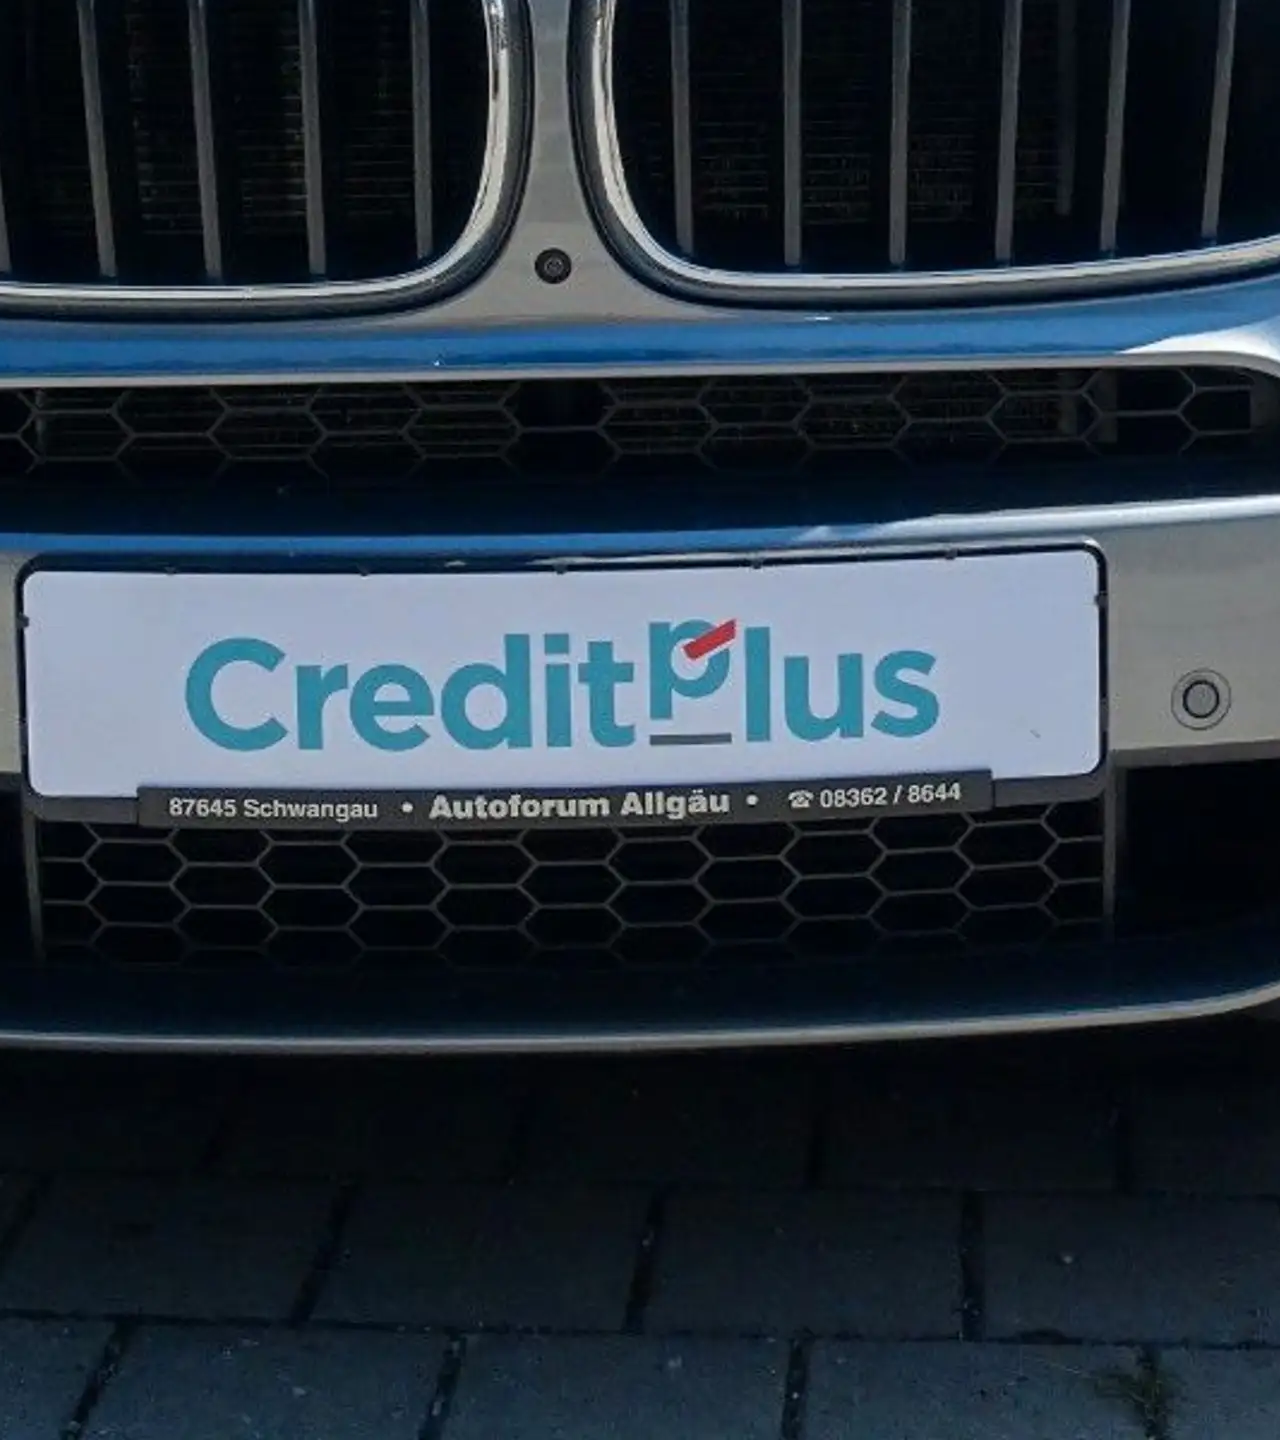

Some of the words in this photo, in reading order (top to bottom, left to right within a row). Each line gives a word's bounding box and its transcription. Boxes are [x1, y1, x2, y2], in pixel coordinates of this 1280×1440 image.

[169, 796, 237, 818] 87645
[243, 798, 378, 823] Schwangau
[429, 793, 610, 819] Autoforum
[620, 789, 730, 820] Allgäu
[819, 787, 889, 809] 08362
[907, 782, 962, 804] 8644
